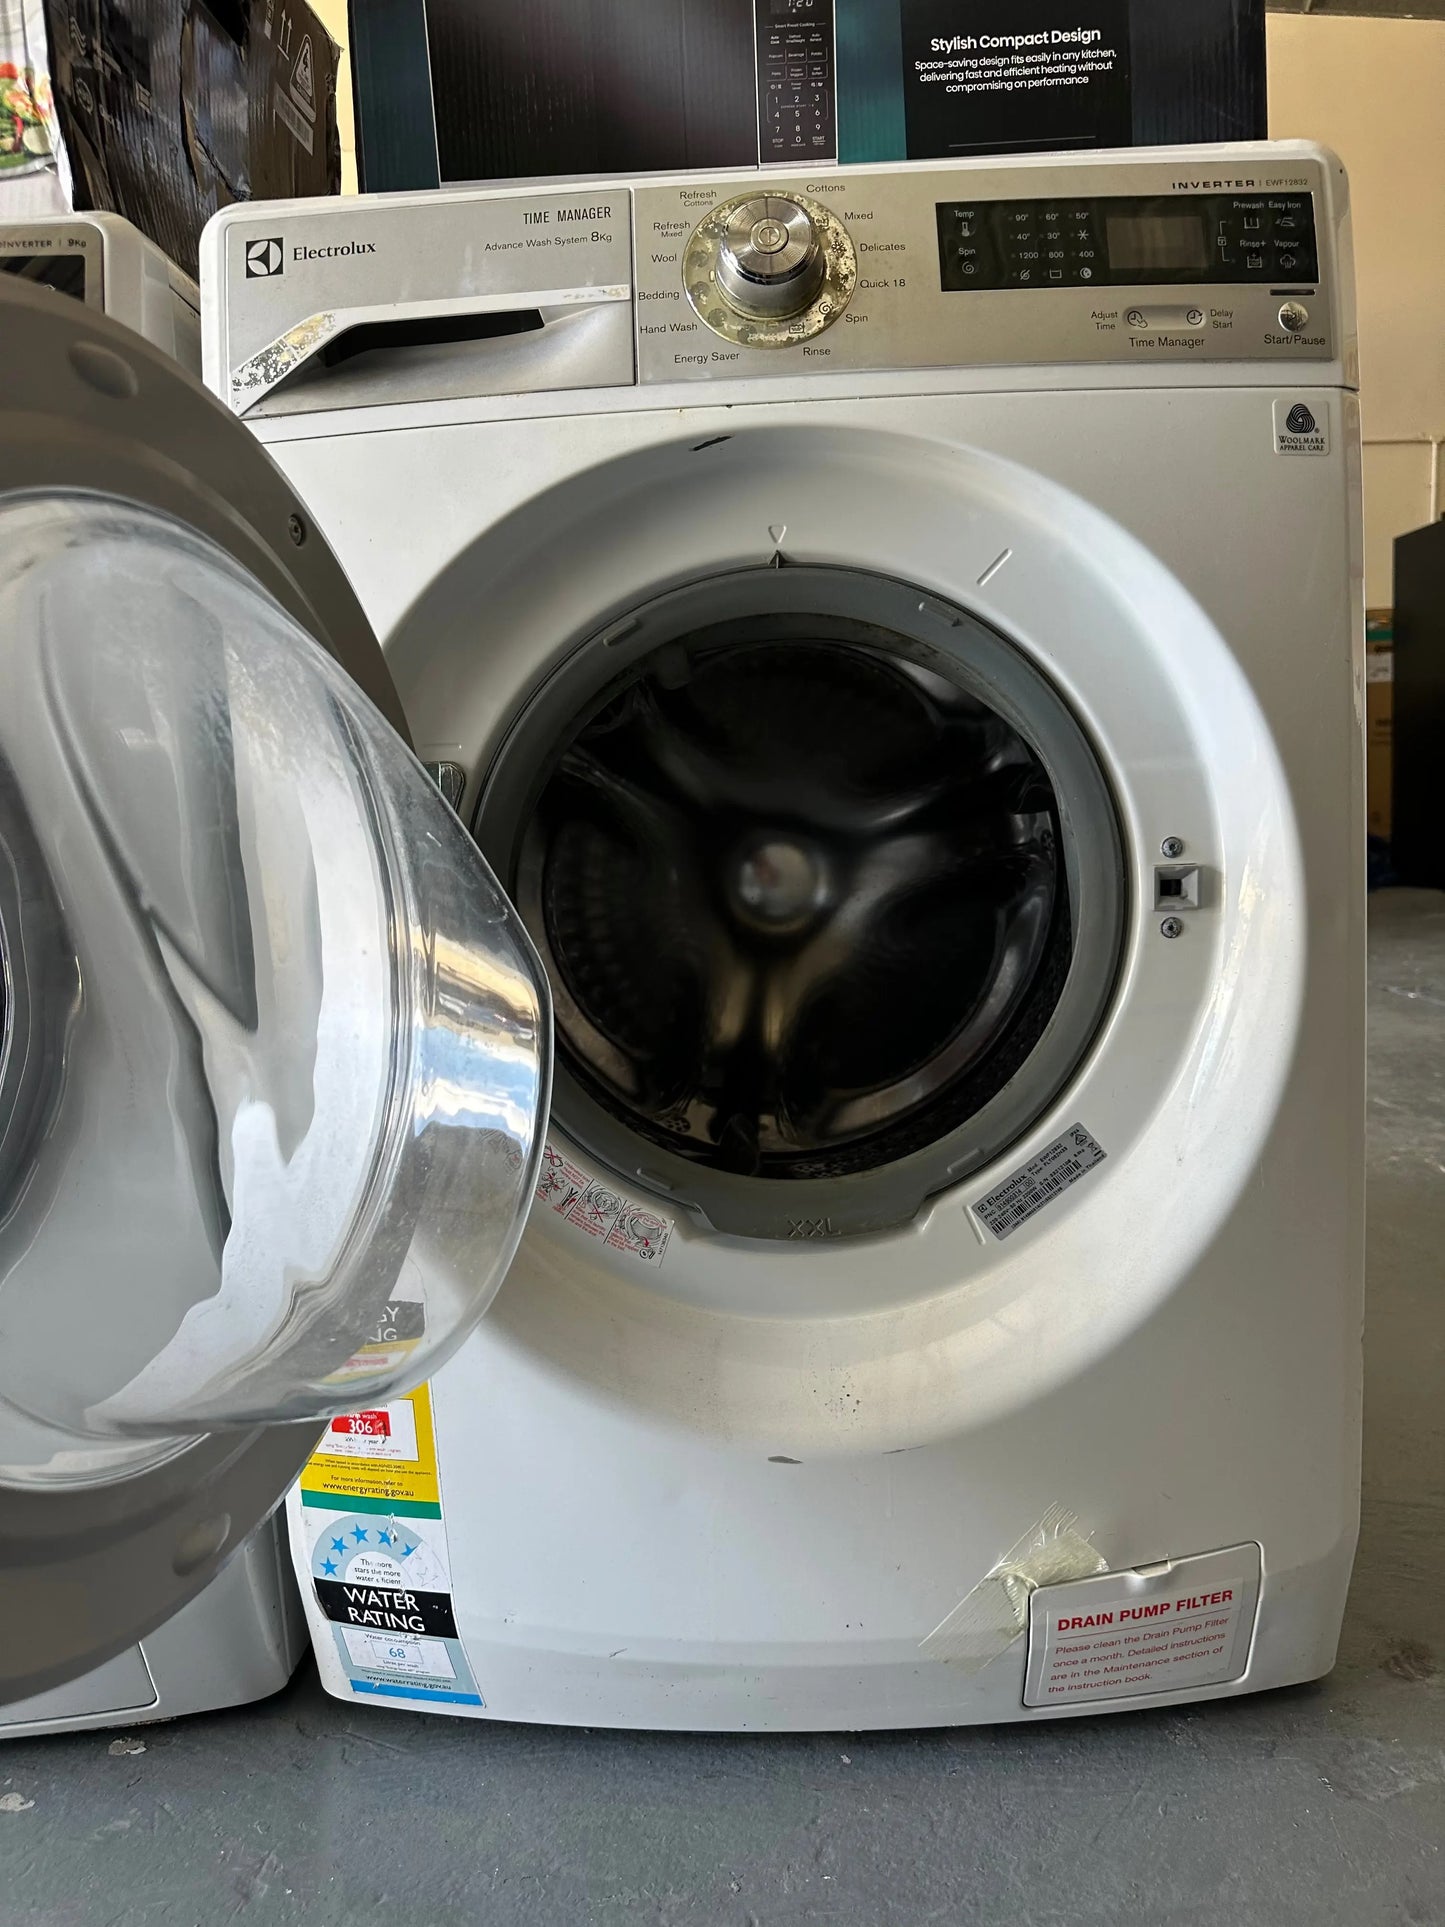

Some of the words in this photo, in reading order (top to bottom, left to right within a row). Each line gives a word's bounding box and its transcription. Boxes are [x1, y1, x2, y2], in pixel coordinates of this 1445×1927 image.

[931, 36, 977, 53] Stylish
[980, 31, 1049, 49] Compact
[1051, 27, 1101, 44] Design
[915, 57, 978, 72] Space-saving
[979, 55, 1010, 68] design
[1011, 53, 1024, 64] fits
[1026, 51, 1052, 63] easily
[1052, 51, 1061, 61] in
[1062, 52, 1080, 62] any
[1081, 48, 1117, 59] kitchen,
[920, 69, 964, 83] delivering
[965, 68, 982, 79] fast
[983, 67, 1002, 78] and
[1003, 64, 1040, 77] efficient
[1041, 62, 1076, 76] heating
[1078, 60, 1113, 72] without
[946, 79, 1013, 93] compromising
[1014, 80, 1027, 88] on
[1028, 75, 1089, 89] performance
[806, 184, 846, 193] Cottons
[1172, 179, 1255, 190] INVERTER
[1266, 178, 1308, 187] EWF12832
[680, 190, 717, 200] Refresh
[684, 199, 713, 207] Cottons
[1233, 201, 1264, 209] Prewash
[1268, 201, 1285, 211] Easy
[523, 211, 550, 224] TIME
[557, 206, 611, 222] MANAGER
[844, 211, 873, 220] Mixed
[954, 210, 974, 219] Temp
[1015, 214, 1029, 222] 90°
[1076, 212, 1089, 220] 50°
[653, 221, 690, 231] Refresh
[661, 230, 682, 238] Mixed
[1047, 232, 1060, 240] 30°
[484, 242, 523, 251] Advance
[526, 238, 551, 247] Wash
[554, 236, 587, 247] System
[591, 231, 612, 243] 8Kg
[1240, 239, 1266, 247] Rinse+
[1274, 239, 1300, 249] Vapour
[293, 241, 376, 261] Electrolux
[860, 243, 906, 252] Delicates
[958, 247, 975, 256] Spin
[651, 254, 677, 263] Wool
[1079, 250, 1094, 258] 400
[860, 279, 889, 289] Quick
[893, 278, 906, 287] 18
[638, 291, 680, 303] Bedding
[845, 314, 868, 324] Spin
[1091, 311, 1118, 322] Adjust
[1210, 309, 1233, 320] Delay
[640, 324, 666, 334] Hand
[669, 323, 698, 332] Wash
[1096, 322, 1115, 330] Time
[1212, 320, 1233, 329] Start
[1129, 337, 1155, 347] Time
[1158, 337, 1205, 349] Manager
[1264, 334, 1326, 346] Start/Pause
[803, 348, 830, 356] Rinse
[674, 353, 708, 364] Energy
[712, 352, 740, 361] Saver
[1279, 436, 1325, 444] WOOLMARK
[986, 1174, 1028, 1207] Electrolux
[787, 1217, 841, 1237] XXL
[348, 1419, 372, 1434] 306
[343, 1586, 419, 1612] WATER
[1058, 1612, 1113, 1631] DRAIN
[1120, 1602, 1171, 1622] PUMP
[1176, 1590, 1233, 1612] FILTER
[347, 1606, 425, 1632] RATING
[1056, 1644, 1090, 1654] Please
[1093, 1639, 1121, 1649] clean
[1124, 1635, 1140, 1644] the
[1143, 1631, 1170, 1641] Drain
[1172, 1624, 1202, 1636] Pump
[1204, 1617, 1230, 1629] Filter
[389, 1647, 406, 1658] 68
[1053, 1659, 1079, 1668] once
[1090, 1652, 1125, 1663] month.
[1127, 1643, 1168, 1657] Detailed
[1171, 1633, 1226, 1649] instructions
[1070, 1670, 1080, 1678] in
[1084, 1668, 1101, 1677] the
[1103, 1657, 1170, 1674] Maintenance
[1172, 1649, 1210, 1662] section
[1212, 1645, 1224, 1654] of
[1048, 1684, 1065, 1693] the
[1067, 1678, 1122, 1691] instruction
[1124, 1673, 1153, 1683] book.
